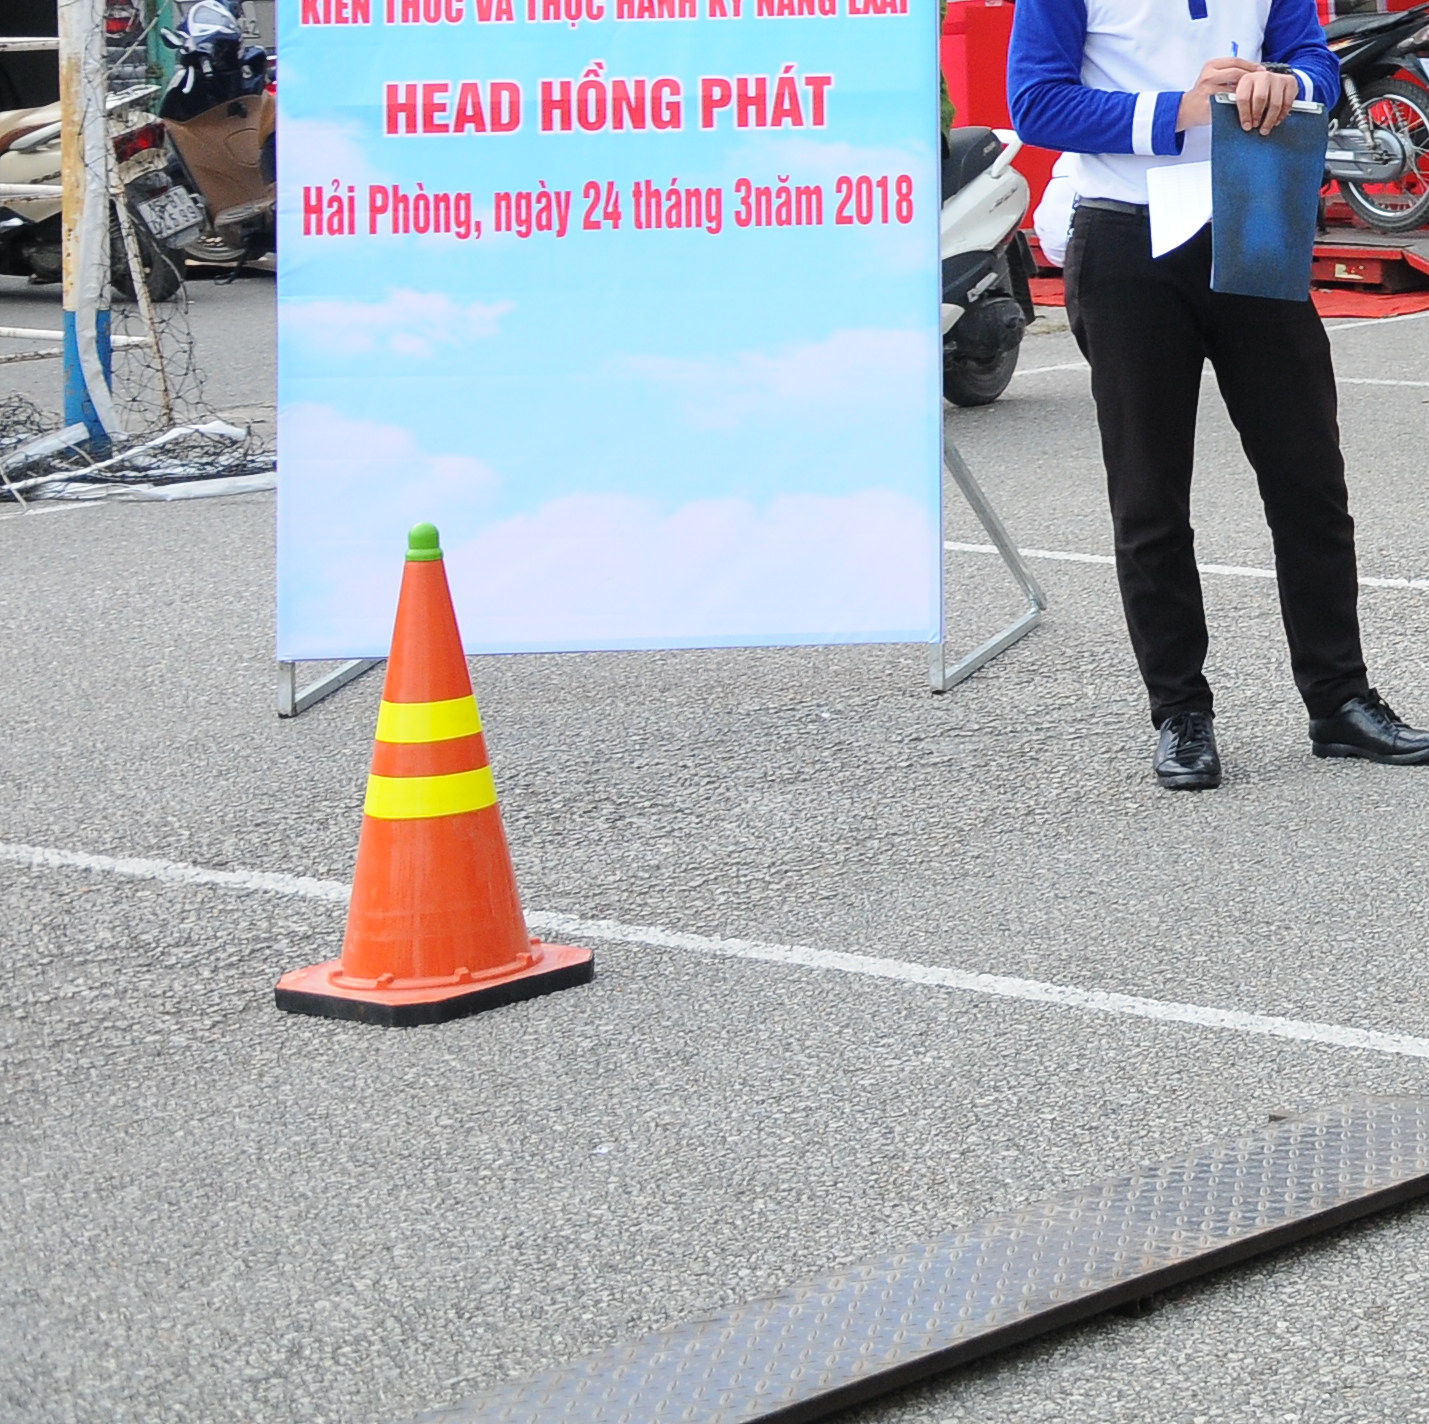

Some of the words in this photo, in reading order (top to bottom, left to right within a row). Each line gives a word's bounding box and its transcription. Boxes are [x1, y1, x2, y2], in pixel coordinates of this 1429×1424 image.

[386, 82, 520, 134] HEAD
[541, 62, 682, 131] HỒNG
[701, 65, 832, 127] PHÁT
[303, 179, 356, 235] Hải
[368, 182, 482, 239] Phòng,
[494, 180, 571, 238] ngày
[583, 181, 621, 230] 24
[632, 178, 722, 234] tháng
[734, 175, 823, 227] 3năm
[835, 175, 914, 225] 2018
